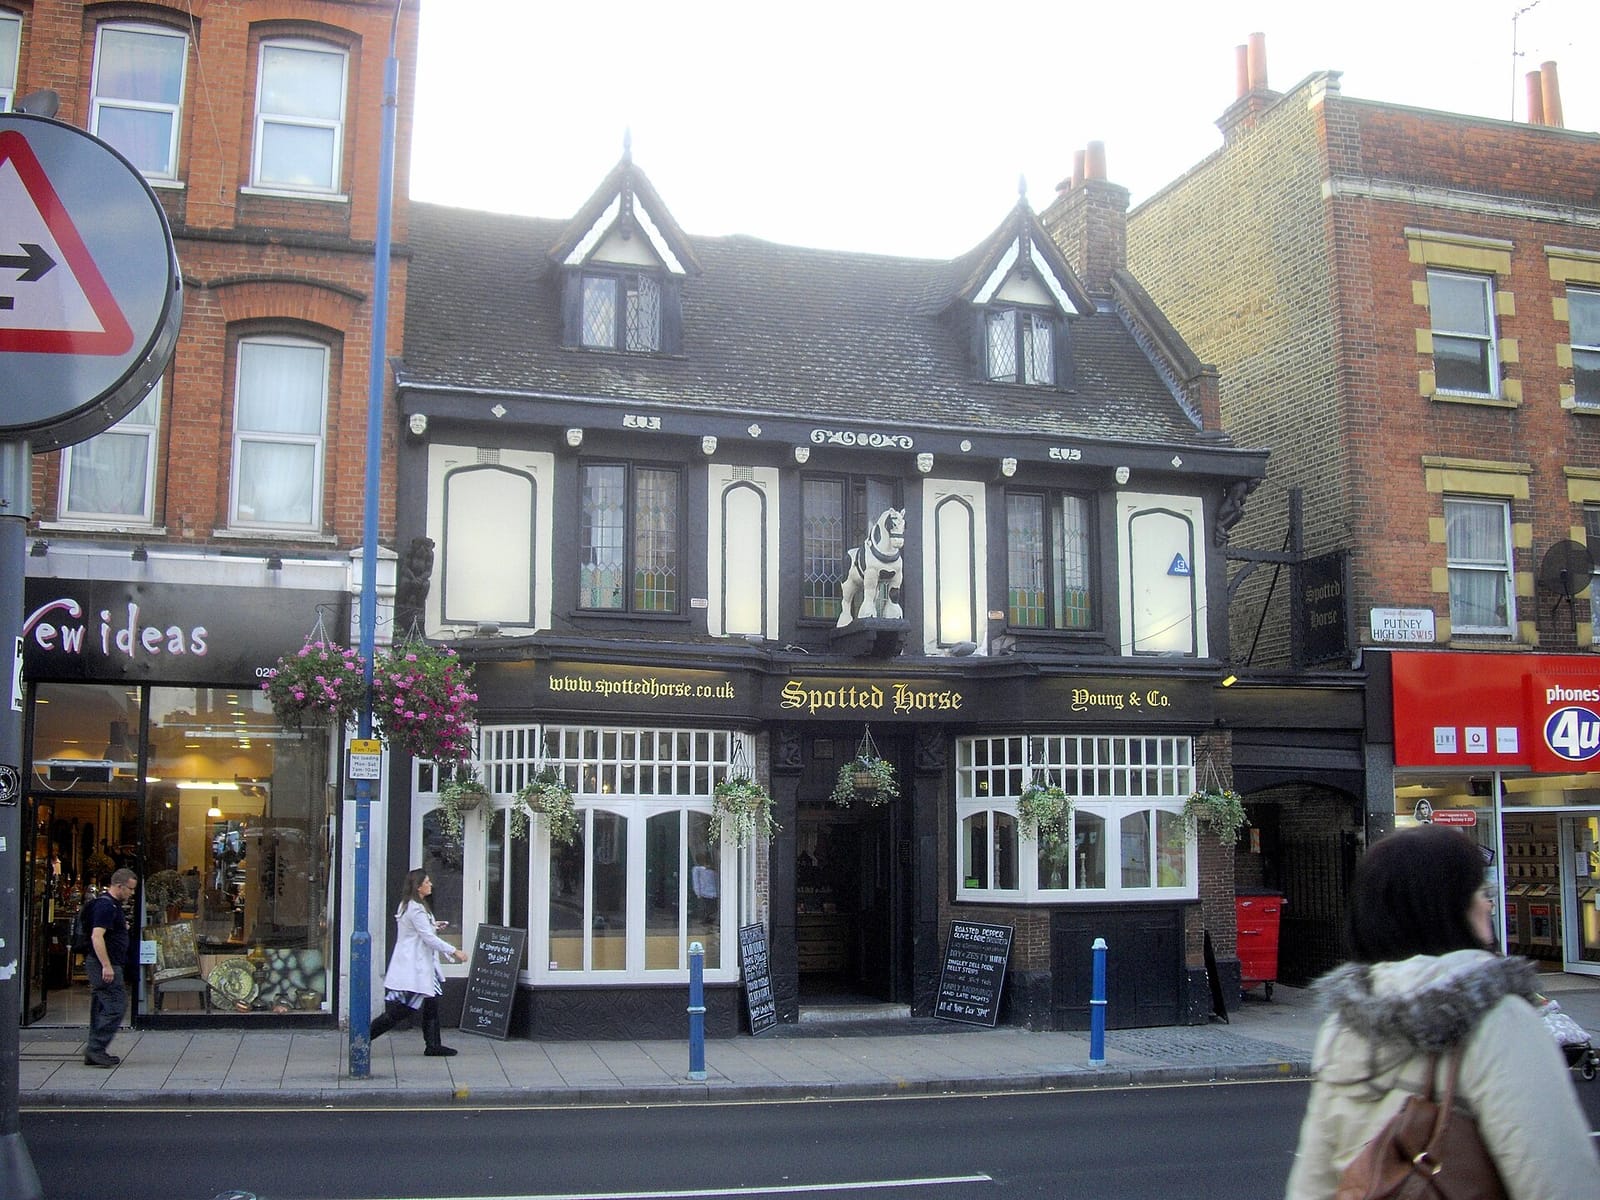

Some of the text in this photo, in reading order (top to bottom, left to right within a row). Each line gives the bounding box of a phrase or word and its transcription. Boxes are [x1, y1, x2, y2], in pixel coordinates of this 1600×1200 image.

[1305, 580, 1341, 604] Spotted
[101, 602, 208, 659] ideas
[1310, 609, 1338, 631] Horse
[1384, 619, 1422, 629] PUTNEY
[1373, 629, 1395, 639] HIGH
[1397, 630, 1408, 639] ST
[549, 675, 736, 699] www.spottedhorse.co.uk
[780, 680, 963, 715] Spotted Horse
[1545, 684, 1600, 705] phones
[1071, 688, 1171, 711] Young & Co.
[1552, 710, 1600, 757] 4u
